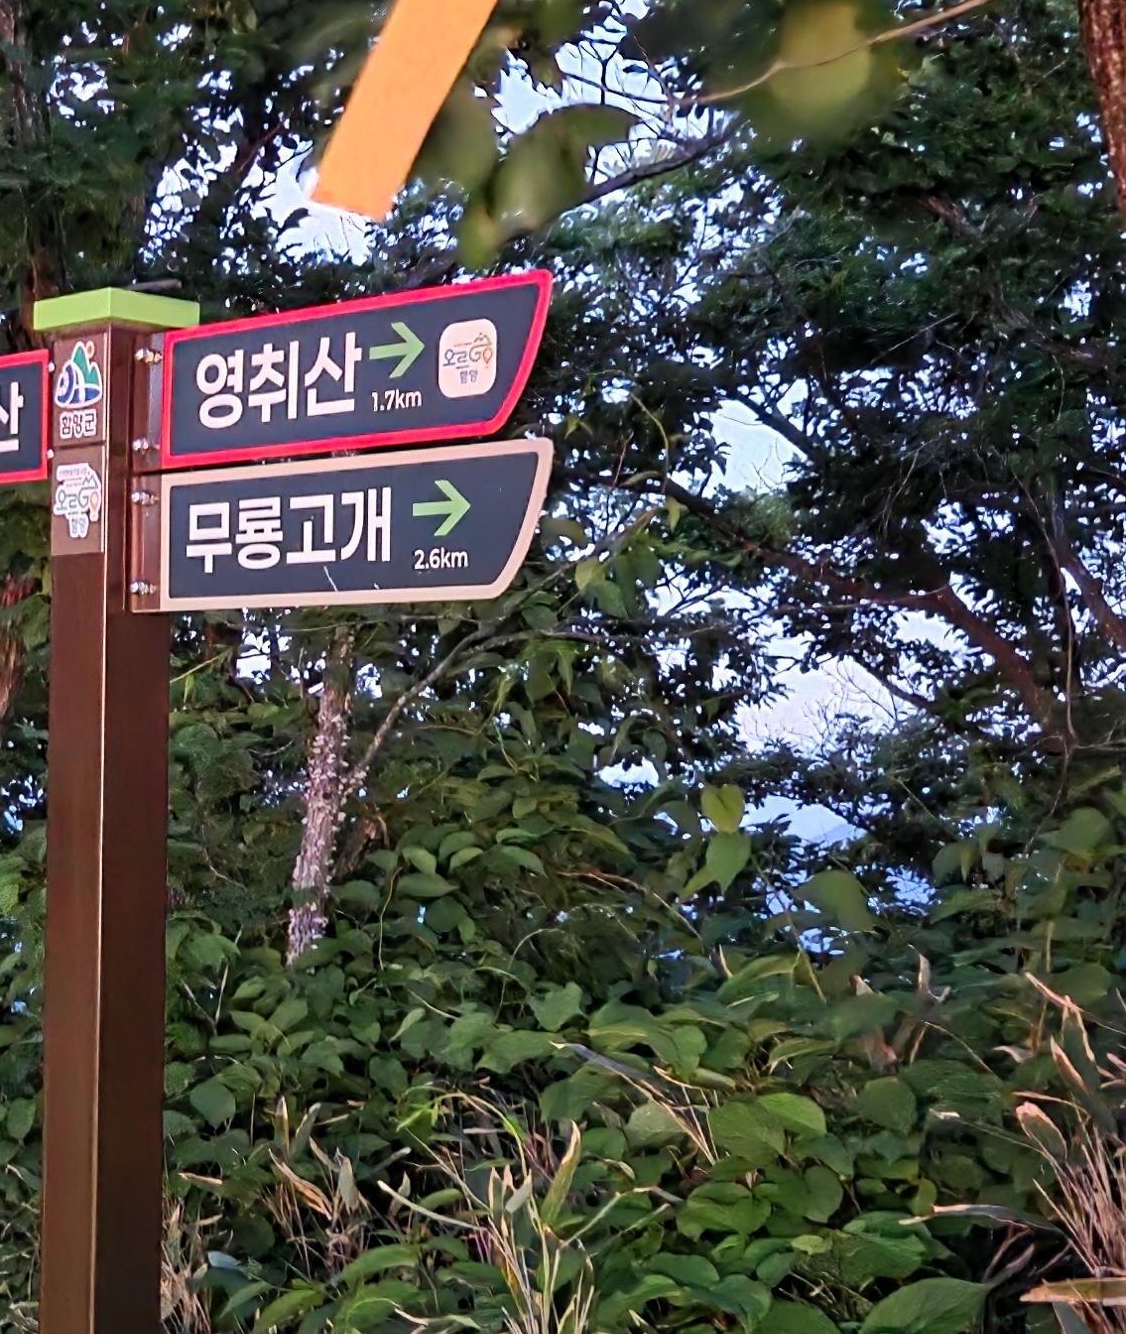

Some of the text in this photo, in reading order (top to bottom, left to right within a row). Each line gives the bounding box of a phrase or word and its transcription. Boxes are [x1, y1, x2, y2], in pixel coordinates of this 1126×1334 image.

[196, 332, 362, 429] 영취산
[372, 389, 423, 412] 1.7km
[61, 411, 96, 437] 함양군
[186, 487, 391, 573] 무룡고개
[414, 547, 468, 570] 2.6km
